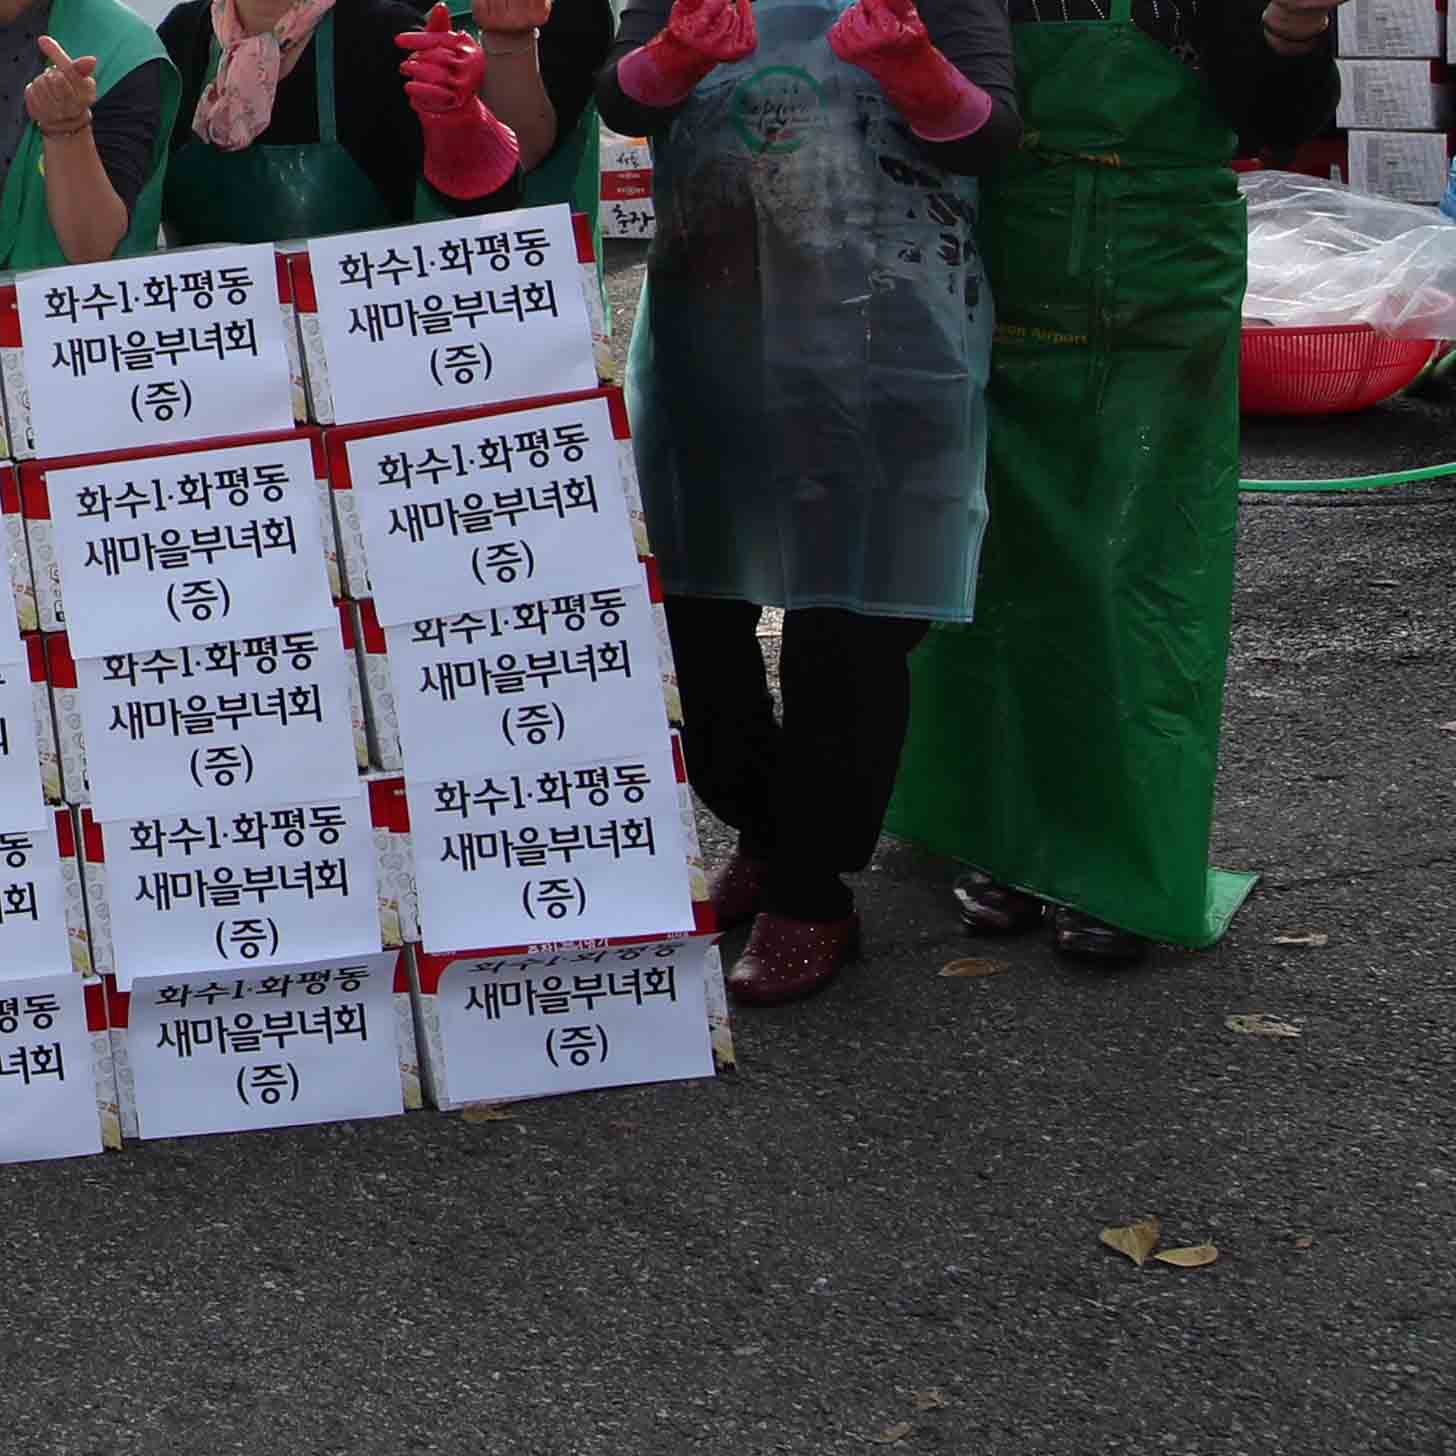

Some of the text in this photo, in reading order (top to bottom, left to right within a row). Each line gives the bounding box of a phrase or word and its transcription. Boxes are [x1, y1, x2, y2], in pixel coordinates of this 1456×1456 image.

[348, 279, 559, 343] 새마을부녀회
[51, 317, 258, 377] 새마을부녀회
[430, 342, 492, 387] (증)
[131, 379, 192, 423] (증)
[388, 474, 599, 544] 새마을부녀회
[84, 515, 297, 577] 새마을부녀회
[471, 539, 534, 585] (증)
[419, 639, 632, 702] 새마을부녀회
[108, 683, 323, 741] 새마을부녀회
[502, 702, 565, 747] (증)
[439, 815, 656, 873] 새마을부녀회
[135, 857, 349, 912] 새마을부녀회
[522, 877, 586, 919] (증)
[464, 965, 678, 1020] 새마을부녀회
[155, 996, 368, 1059] 새마을부녀회
